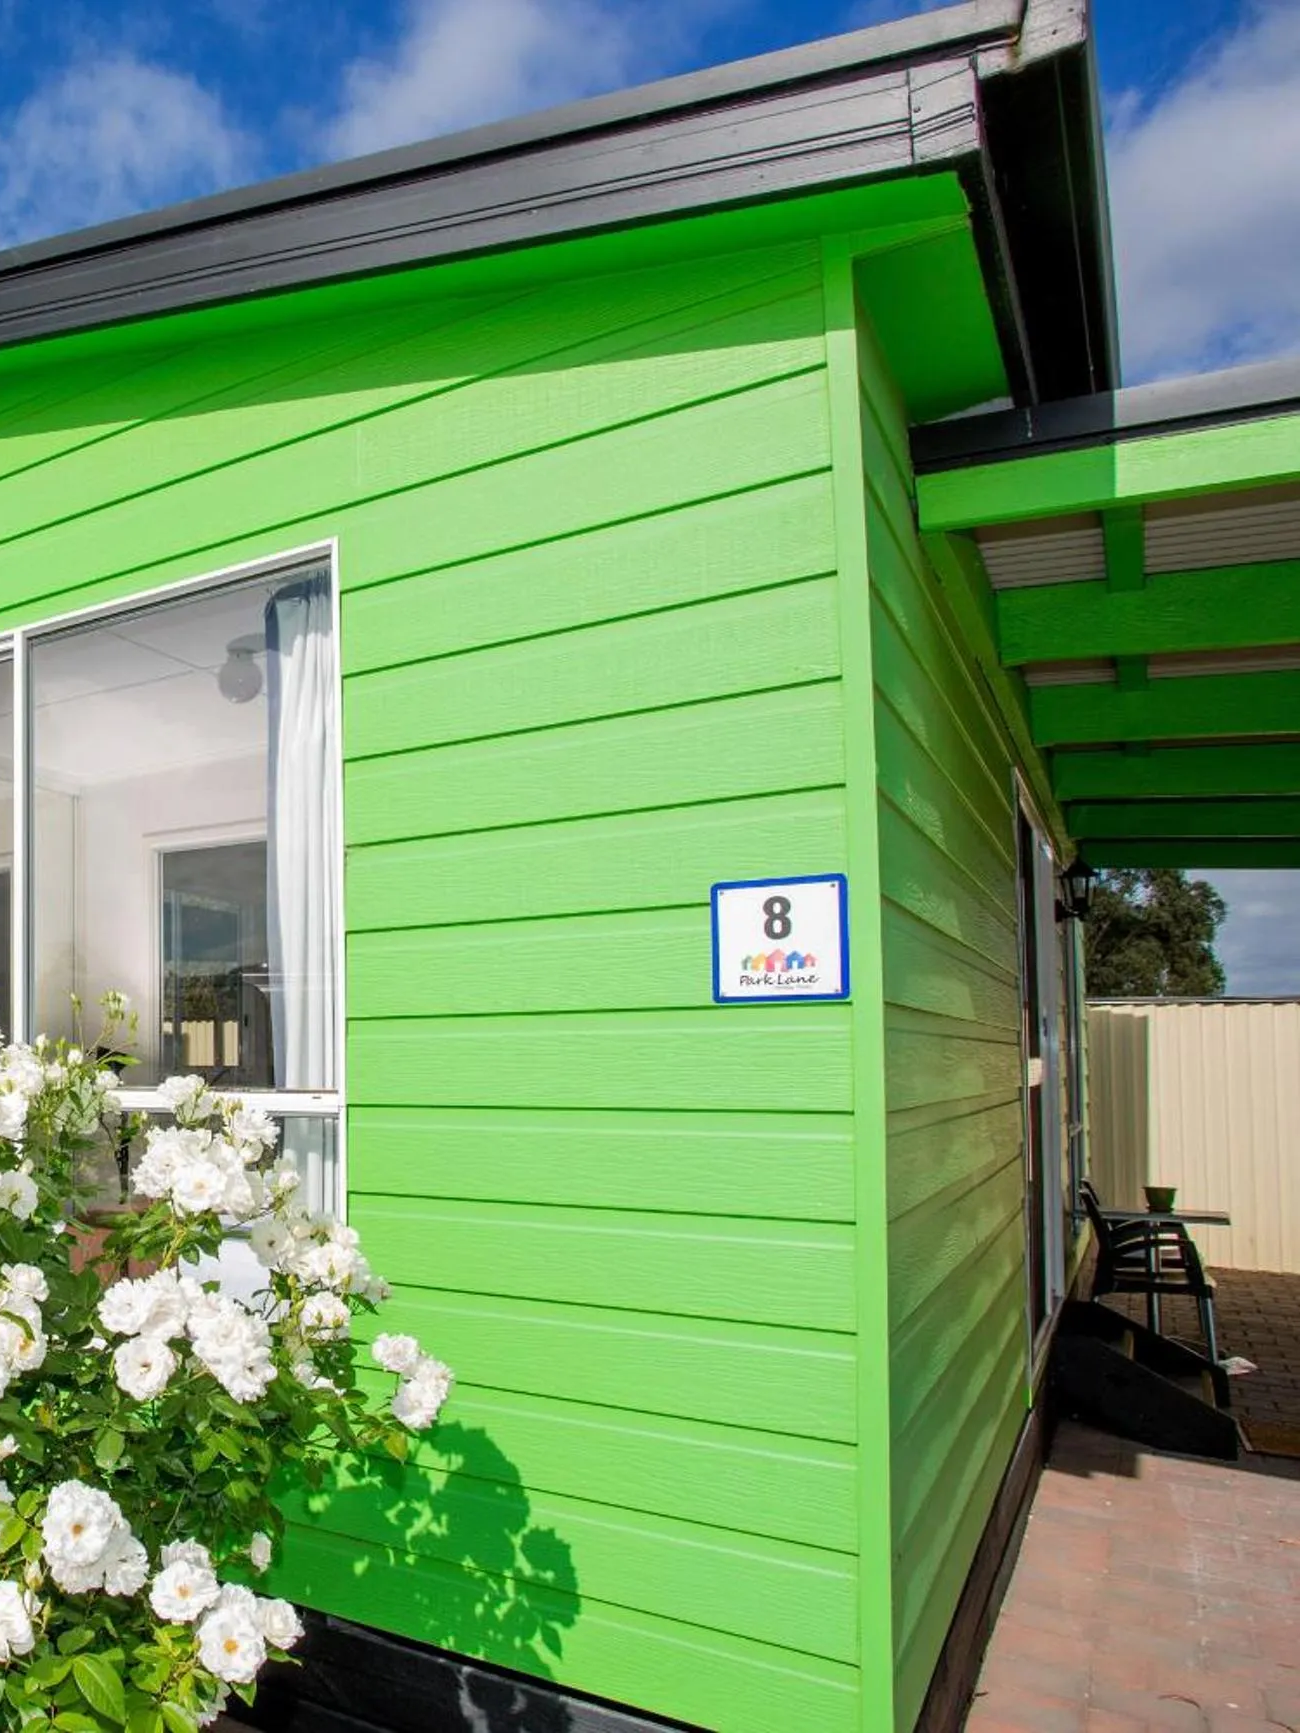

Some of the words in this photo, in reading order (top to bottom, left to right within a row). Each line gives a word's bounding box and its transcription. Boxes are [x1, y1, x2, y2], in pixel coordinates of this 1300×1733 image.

[763, 896, 792, 940] 8
[740, 974, 774, 987] Park
[777, 974, 819, 986] Lane
